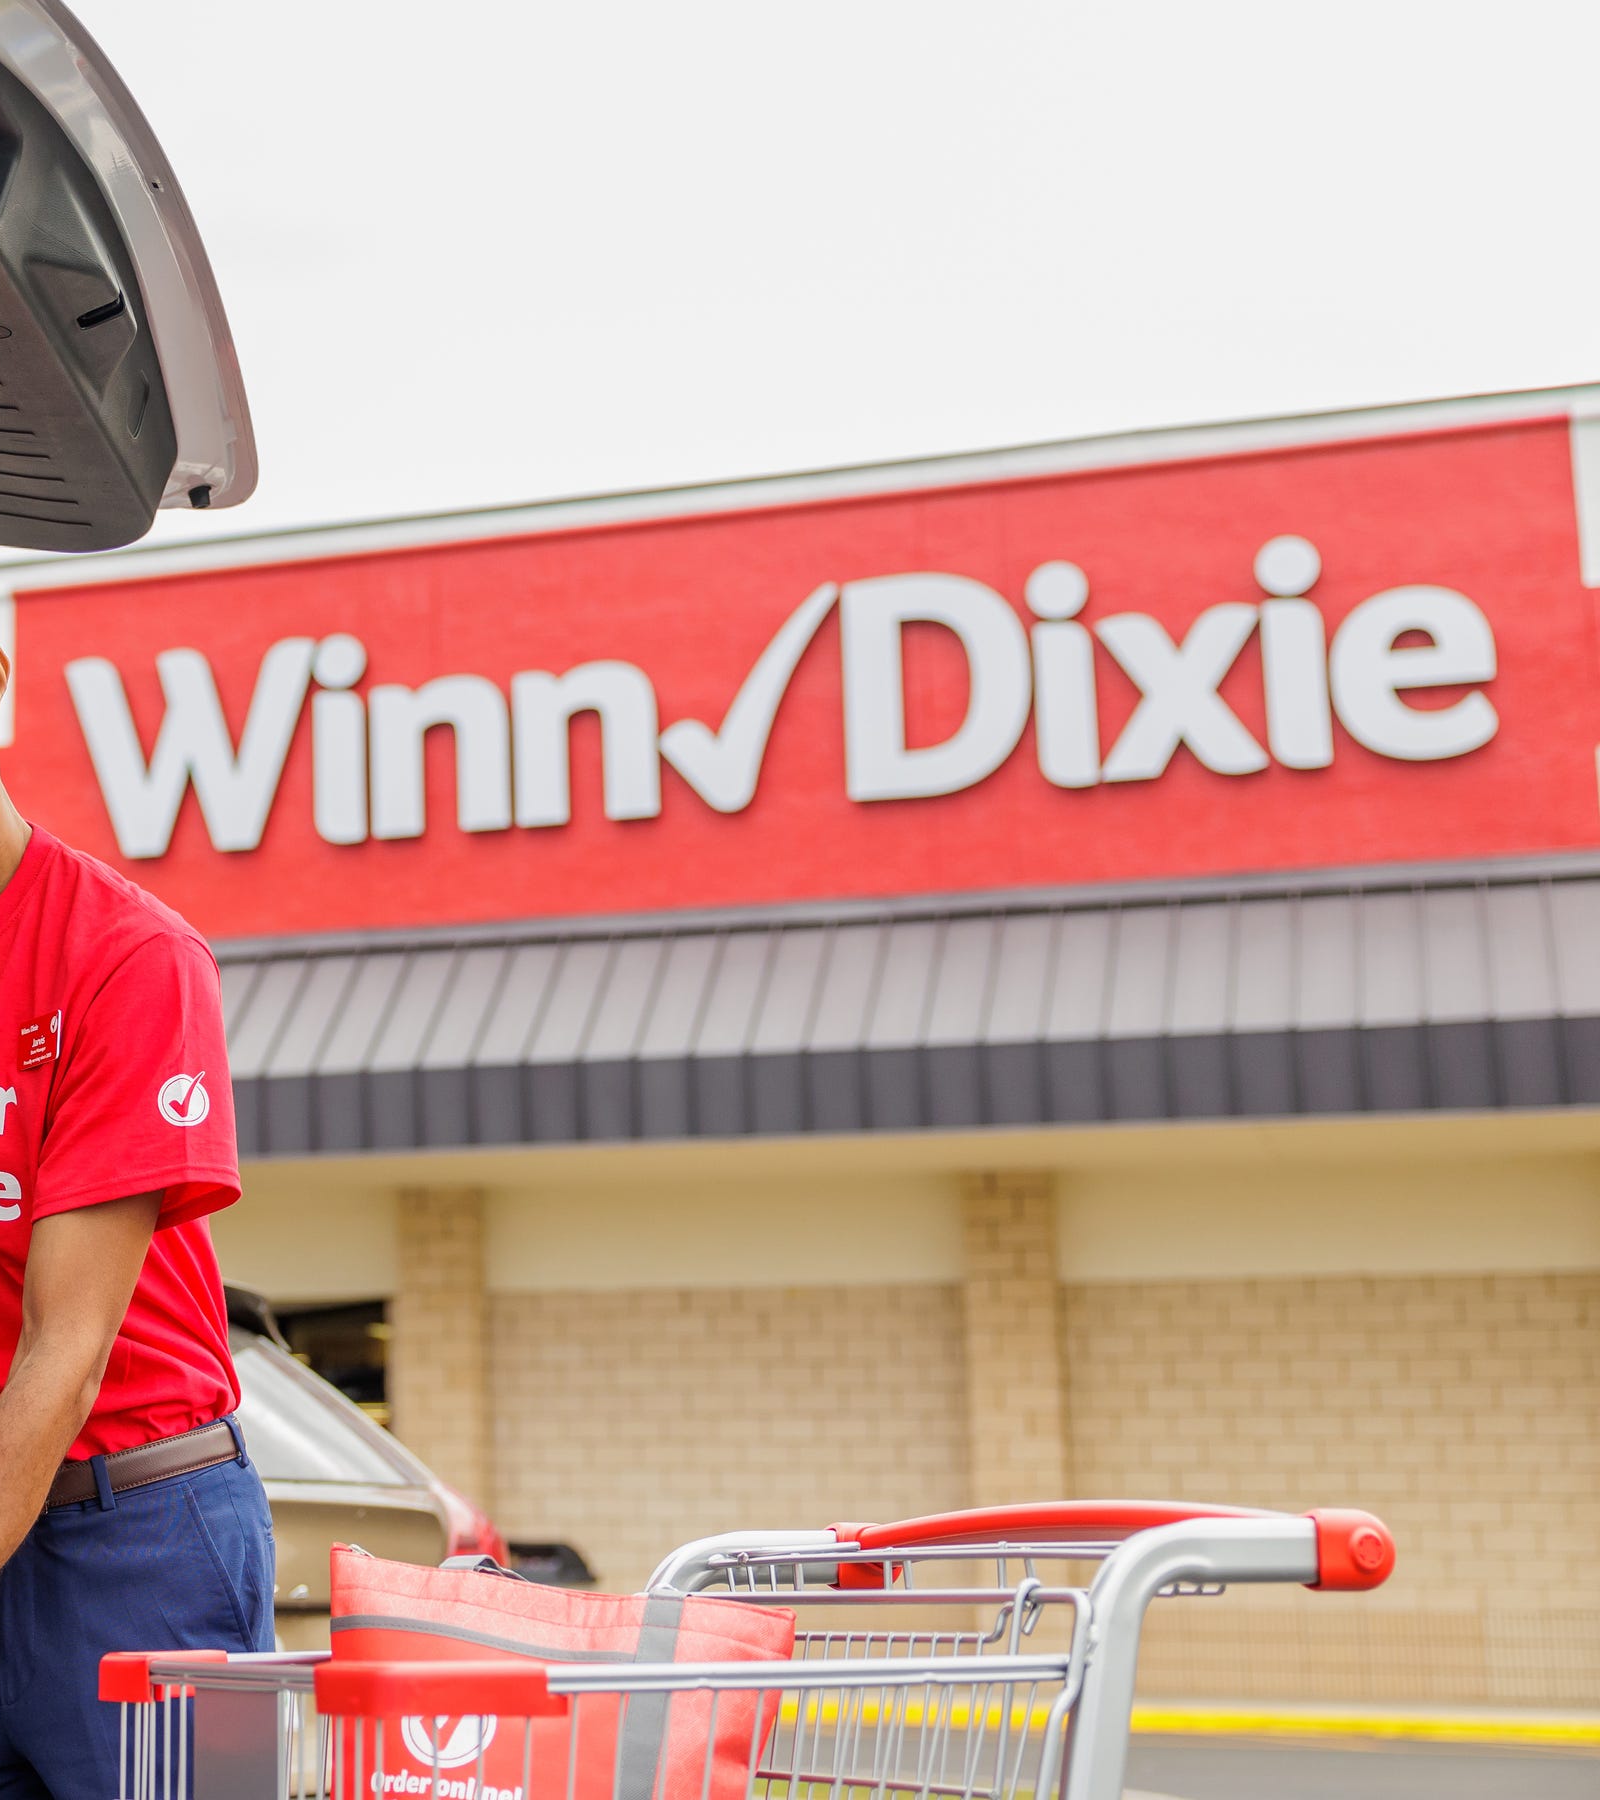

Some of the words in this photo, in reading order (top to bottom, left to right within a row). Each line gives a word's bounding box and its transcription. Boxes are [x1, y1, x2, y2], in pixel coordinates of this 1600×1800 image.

[64, 632, 663, 860] Winn
[839, 534, 1500, 805] Dixie
[371, 1768, 432, 1794] Order
[436, 1777, 523, 1800] onlne!
